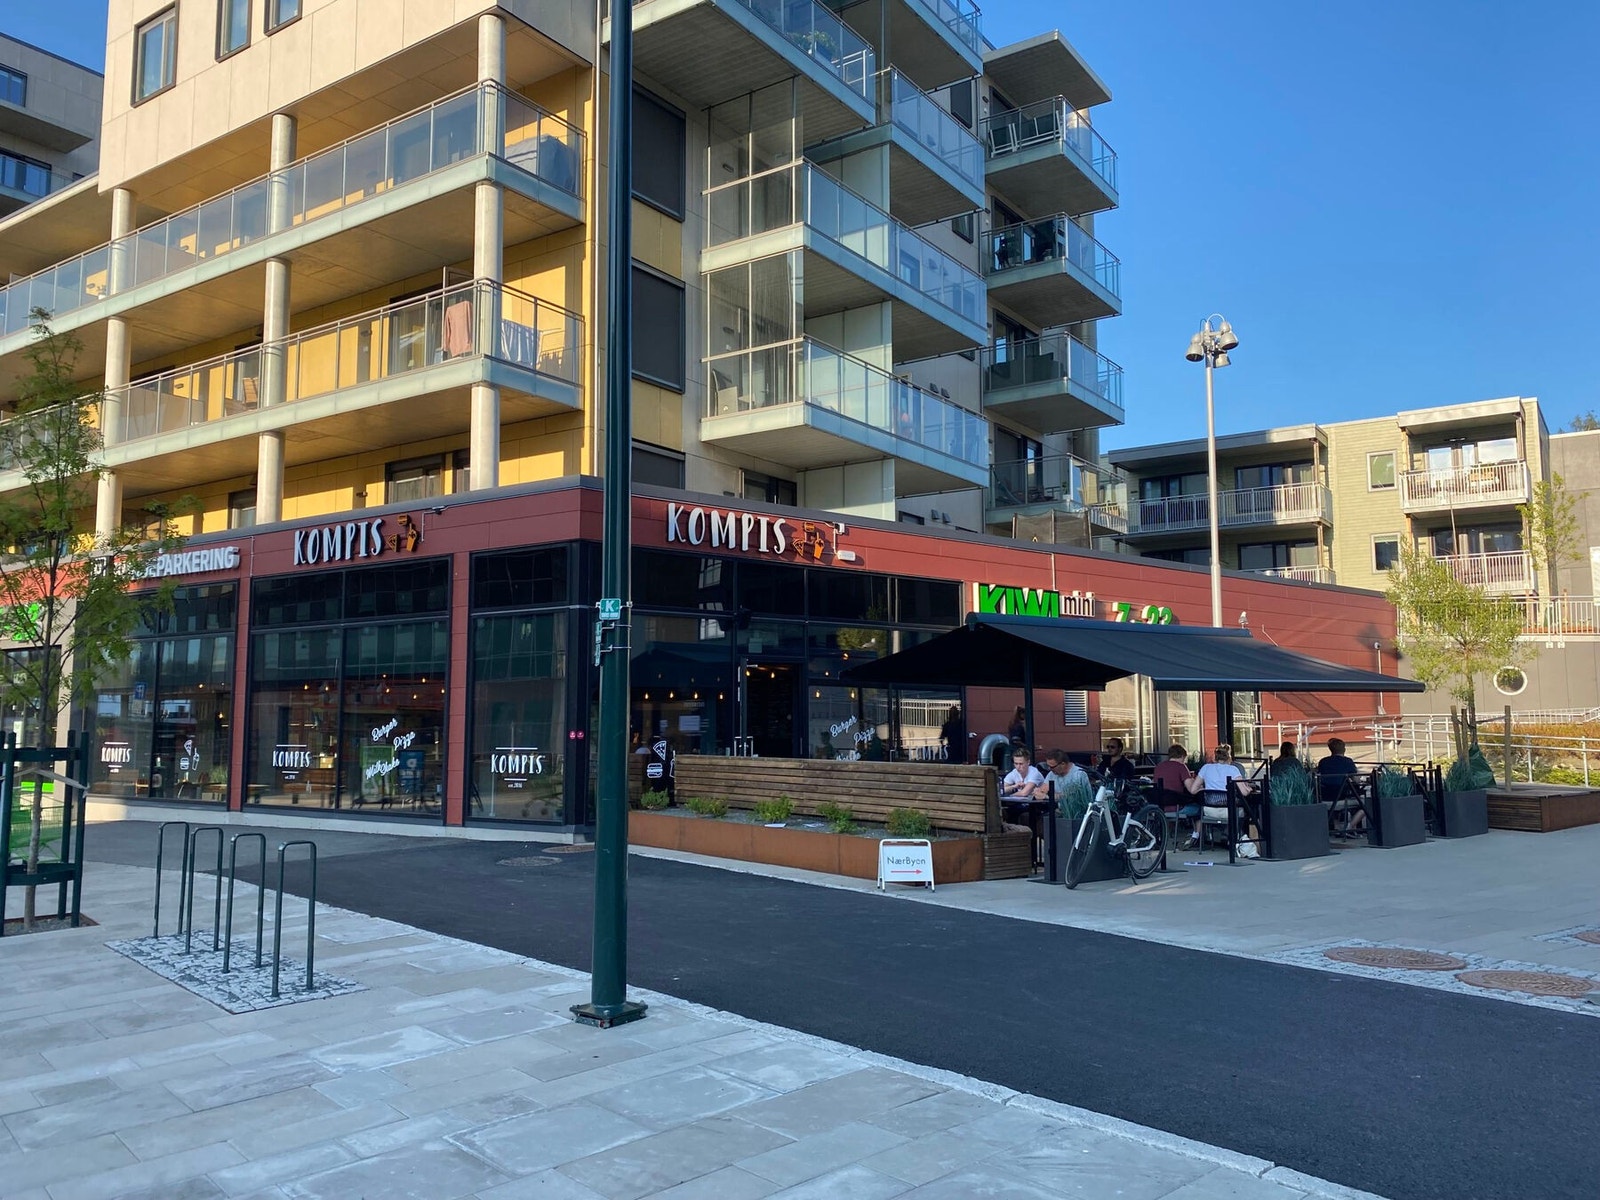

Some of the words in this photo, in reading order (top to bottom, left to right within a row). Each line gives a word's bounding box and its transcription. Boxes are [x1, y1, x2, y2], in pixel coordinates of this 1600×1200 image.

[668, 503, 785, 554] KOMPIS
[293, 518, 382, 566] KOMPIS
[605, 600, 615, 612] K
[974, 582, 1060, 618] KIWI
[1061, 590, 1096, 617] mini
[830, 715, 857, 737] Burger
[100, 747, 132, 762] KOMPIS
[272, 750, 311, 767] KOMPIS
[491, 753, 544, 774] KOMPIS
